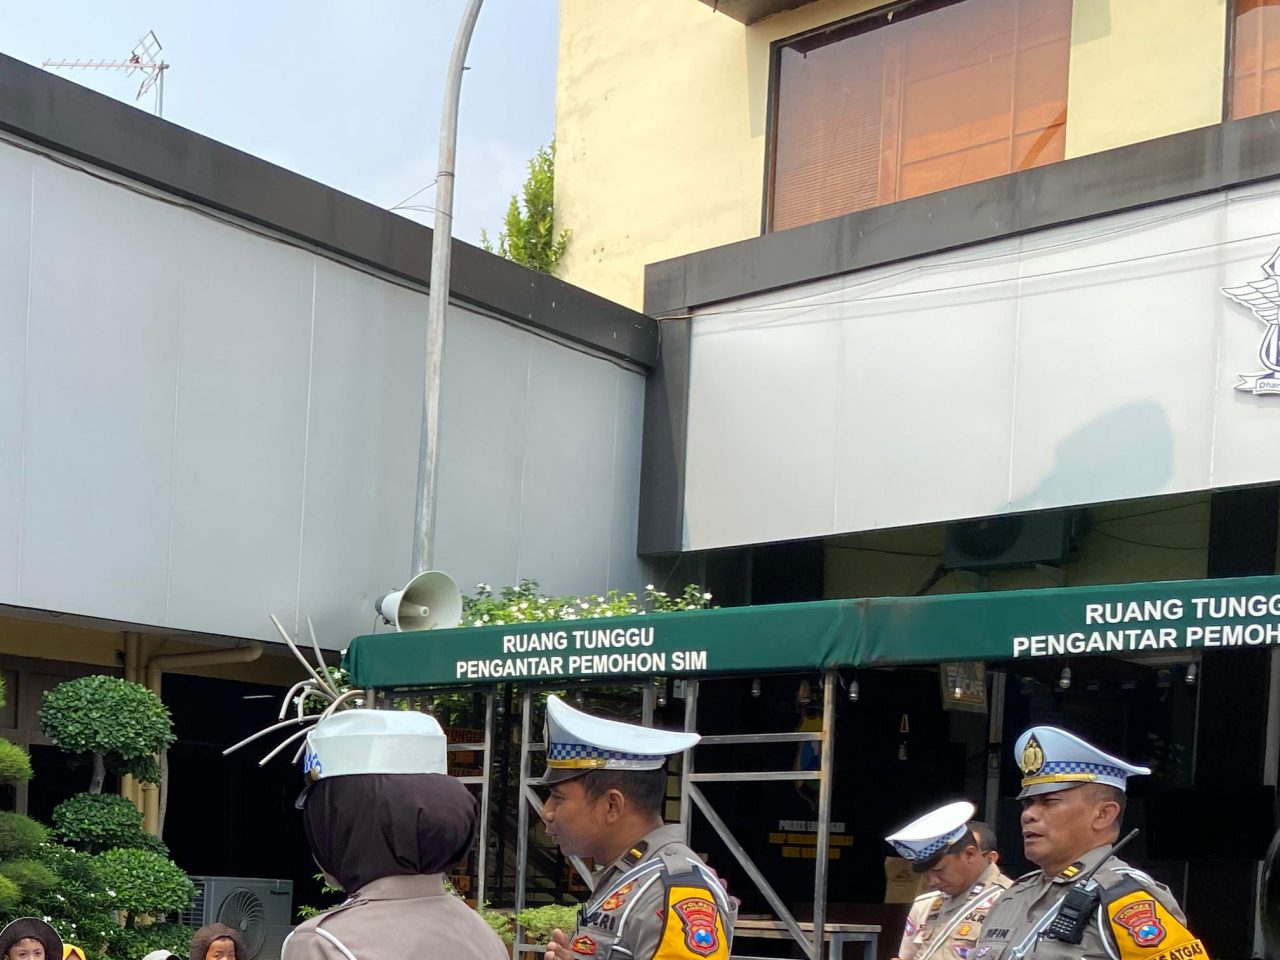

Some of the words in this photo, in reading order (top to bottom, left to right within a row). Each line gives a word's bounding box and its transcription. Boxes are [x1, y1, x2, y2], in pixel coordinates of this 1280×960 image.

[1084, 599, 1184, 625] RUANG
[1191, 595, 1280, 619] TUNGG
[503, 631, 568, 653] RUANG
[572, 627, 655, 649] TUNGGU
[1012, 627, 1178, 658] PENGANTAR
[1185, 623, 1280, 647] PEMOH
[456, 656, 563, 679] PENGANTAR
[568, 652, 666, 675] PEMOHON
[671, 650, 708, 671] SIM
